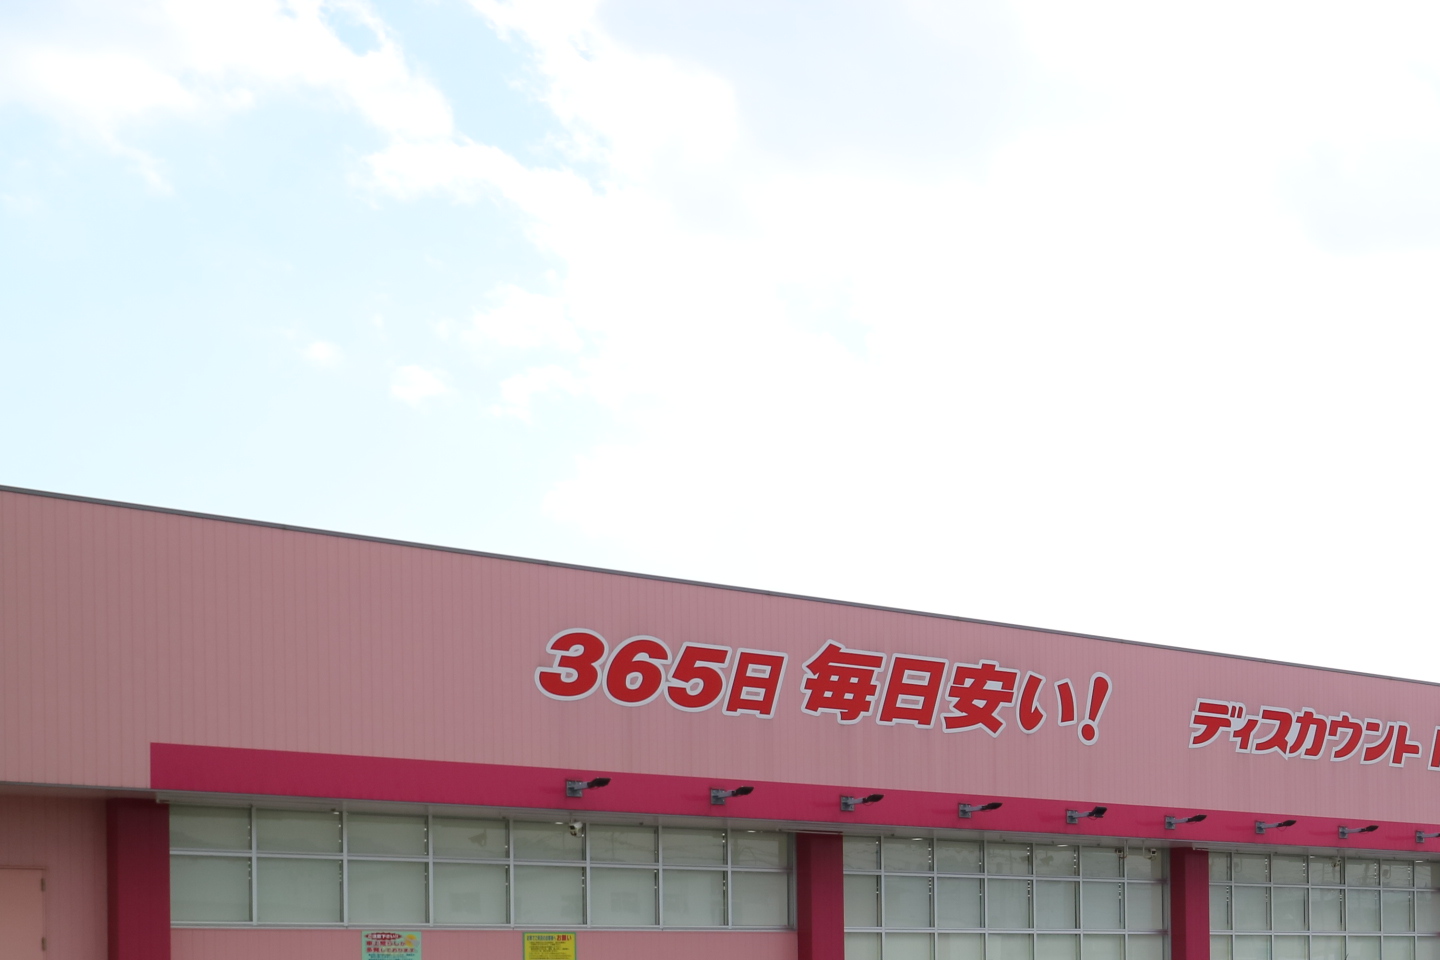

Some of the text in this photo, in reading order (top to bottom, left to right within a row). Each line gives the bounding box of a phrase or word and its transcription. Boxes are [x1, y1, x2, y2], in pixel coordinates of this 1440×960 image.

[534, 628, 1112, 746] 365日 毎日安い!
[1189, 698, 1421, 768] ディスカウント
